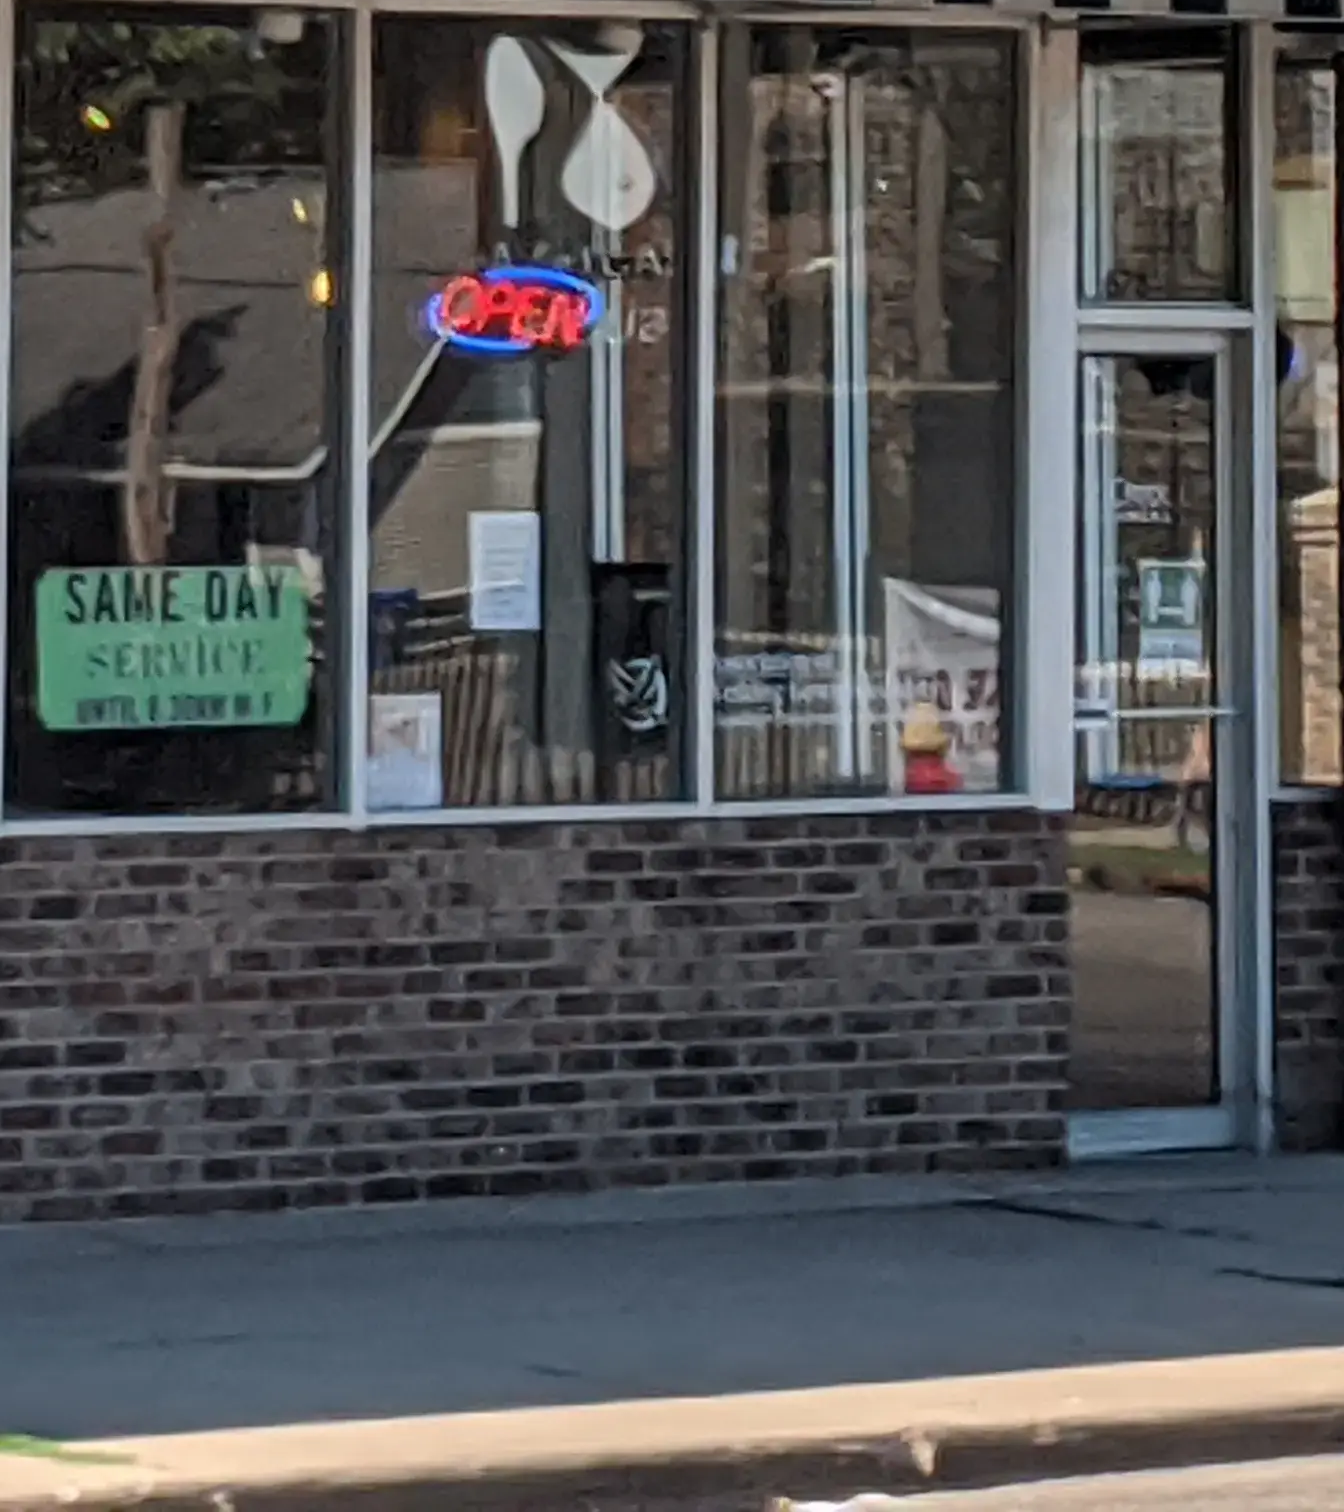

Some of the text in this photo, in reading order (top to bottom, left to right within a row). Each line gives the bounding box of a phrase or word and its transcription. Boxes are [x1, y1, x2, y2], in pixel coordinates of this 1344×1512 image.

[441, 276, 591, 348] OPEN
[65, 569, 285, 624] SAME DAY
[86, 634, 266, 679] SERVICE
